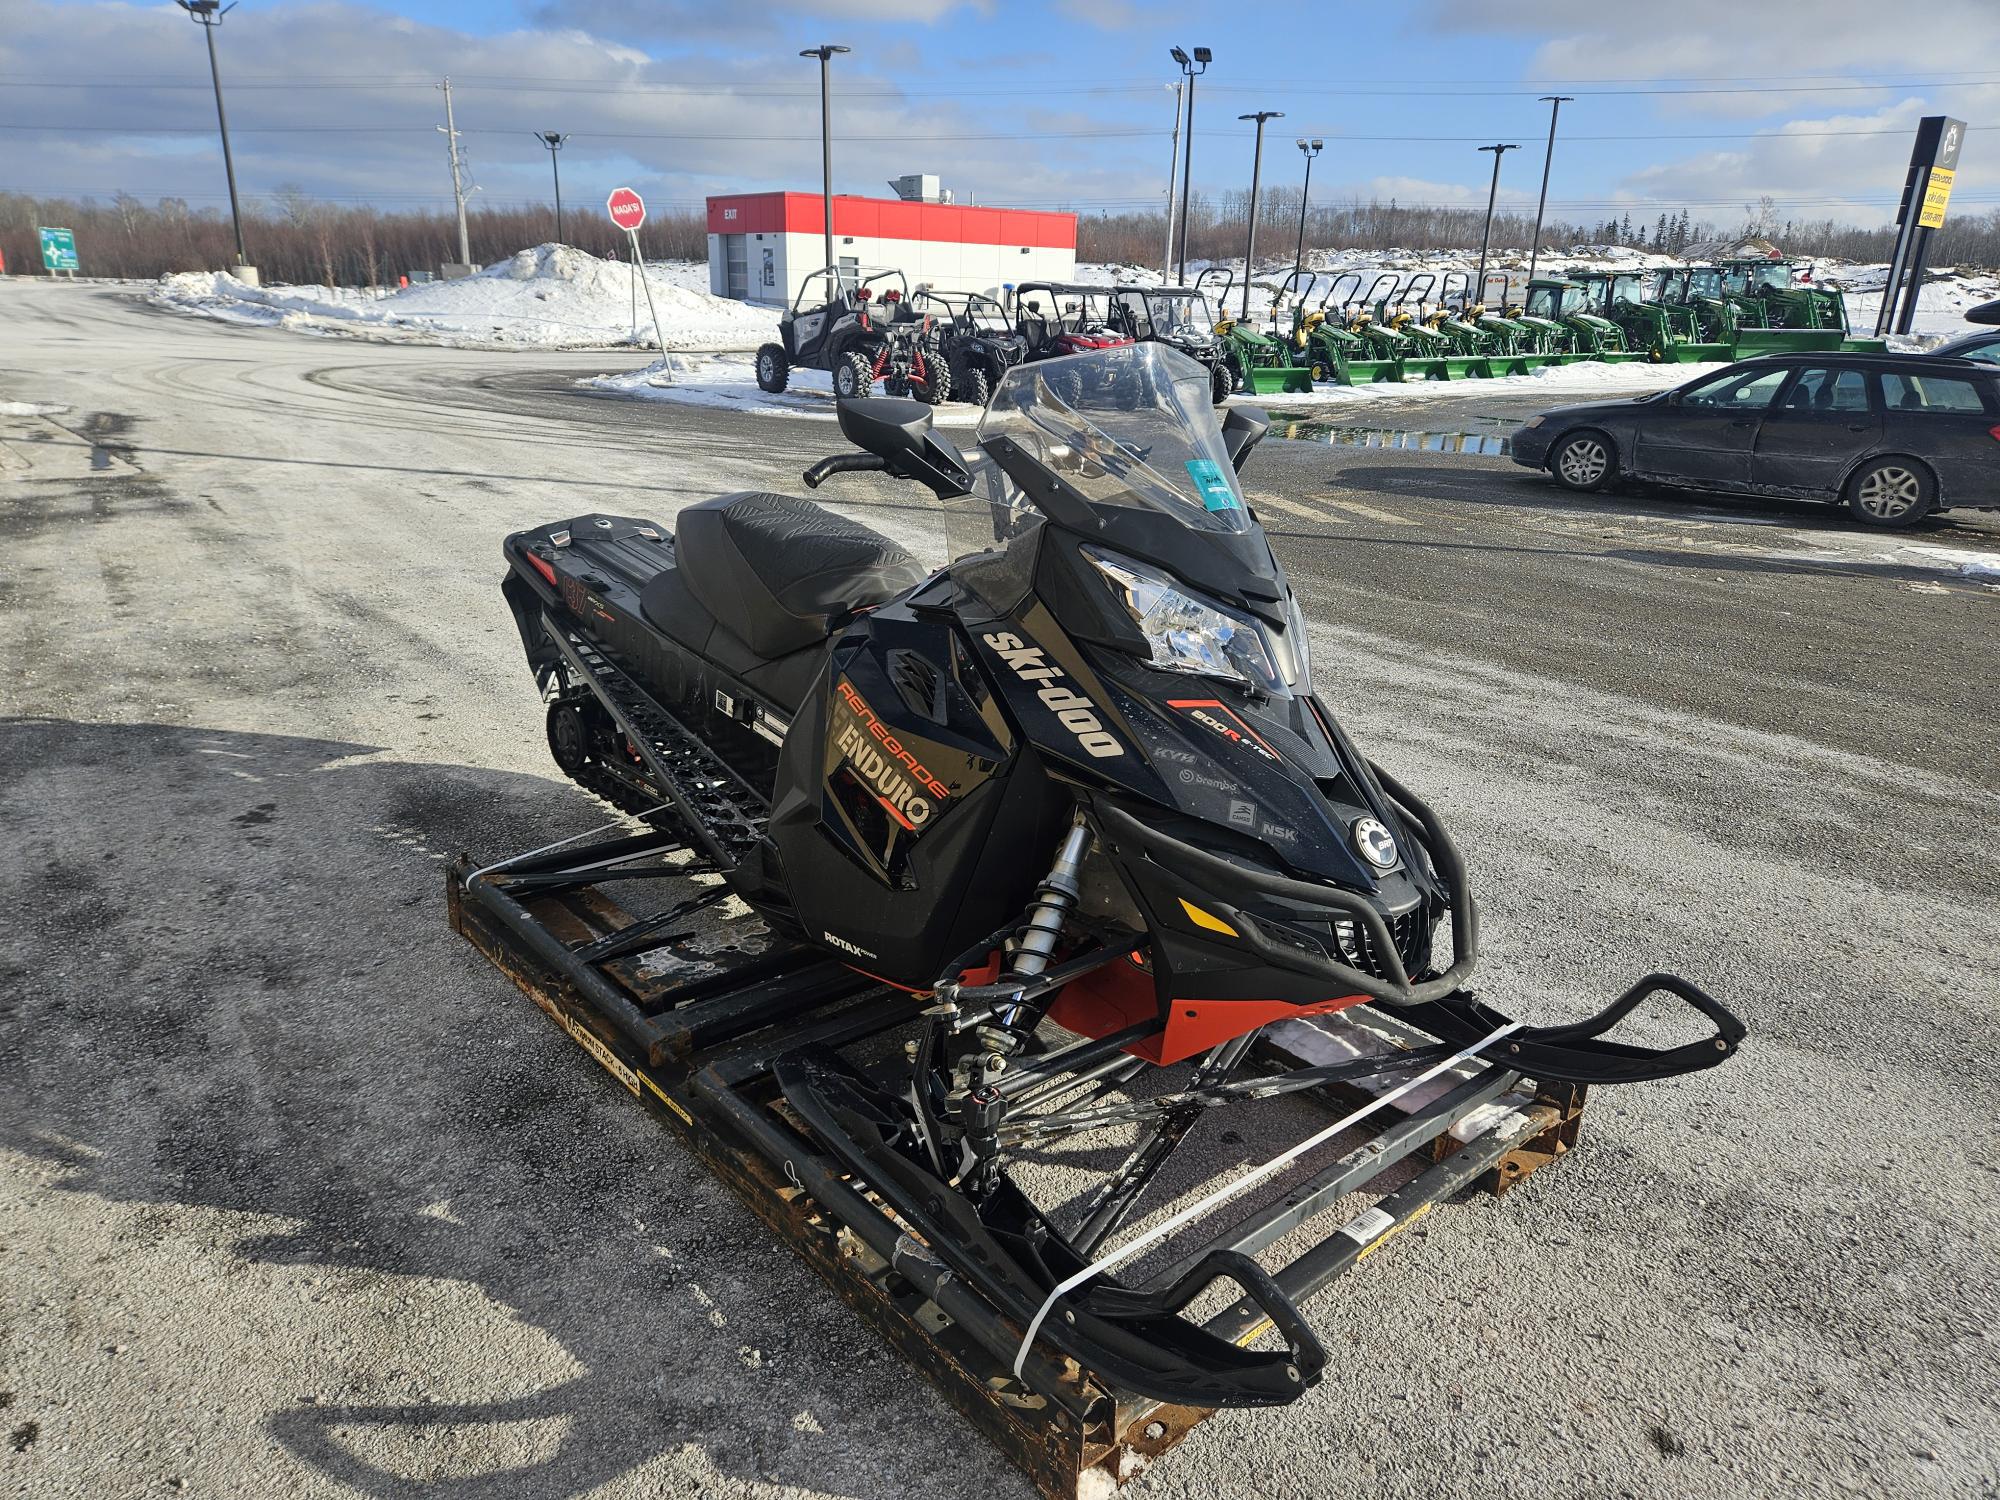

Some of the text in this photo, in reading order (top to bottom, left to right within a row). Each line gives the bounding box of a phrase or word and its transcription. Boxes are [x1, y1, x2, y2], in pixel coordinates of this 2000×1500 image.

[724, 209, 737, 220] EXIT
[983, 631, 1125, 759] ski-doo
[1191, 709, 1241, 742] 800R
[836, 681, 951, 801] RENEGADE
[837, 722, 930, 825] ENDURO
[1196, 774, 1238, 791] brembo
[1262, 822, 1297, 841] NSK
[1378, 839, 1393, 851] BRP
[824, 931, 862, 957] ROTAX
[595, 1044, 616, 1067] STACK
[622, 1069, 638, 1089] HIGH
